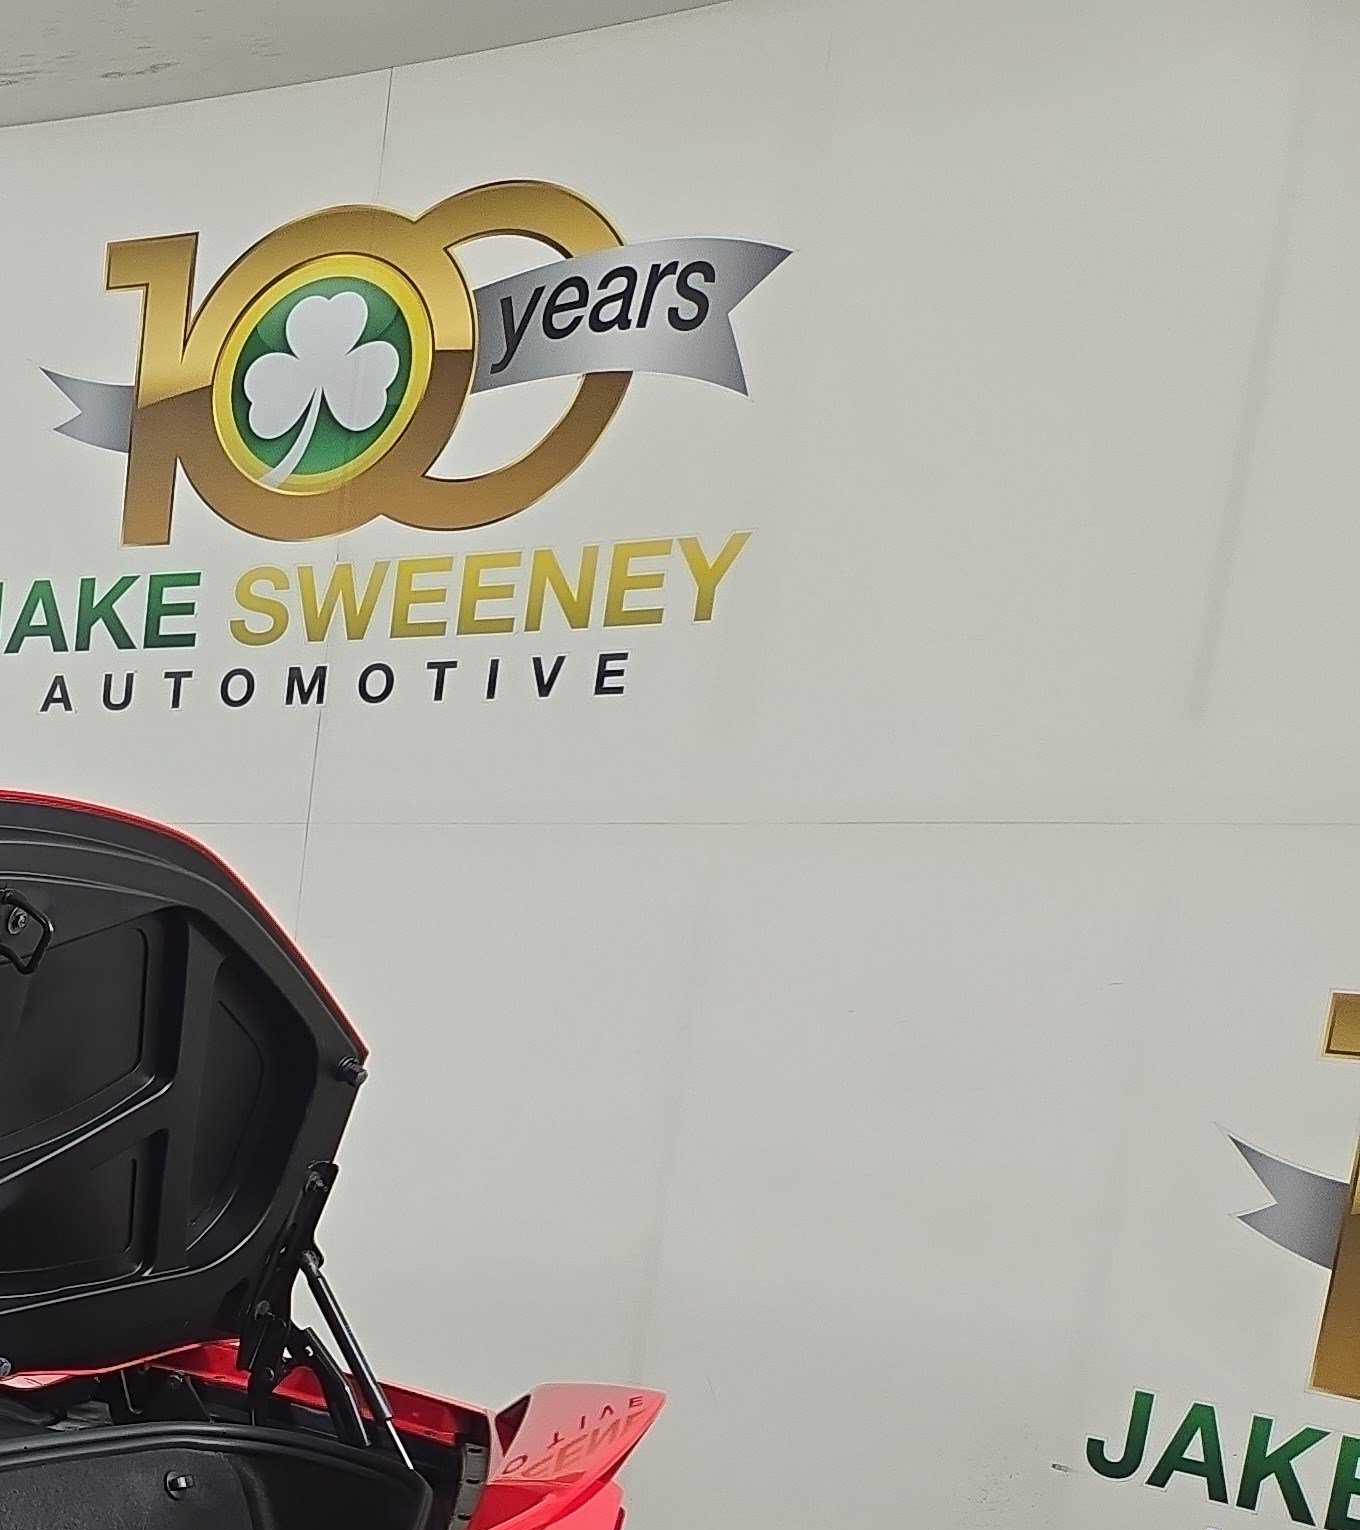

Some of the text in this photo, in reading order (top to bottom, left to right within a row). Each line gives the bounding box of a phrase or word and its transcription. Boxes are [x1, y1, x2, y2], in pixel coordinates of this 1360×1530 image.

[105, 179, 634, 547] 100
[490, 258, 717, 374] years
[229, 530, 753, 648] SWEENEY
[40, 652, 630, 714] AUTOMOTIVE
